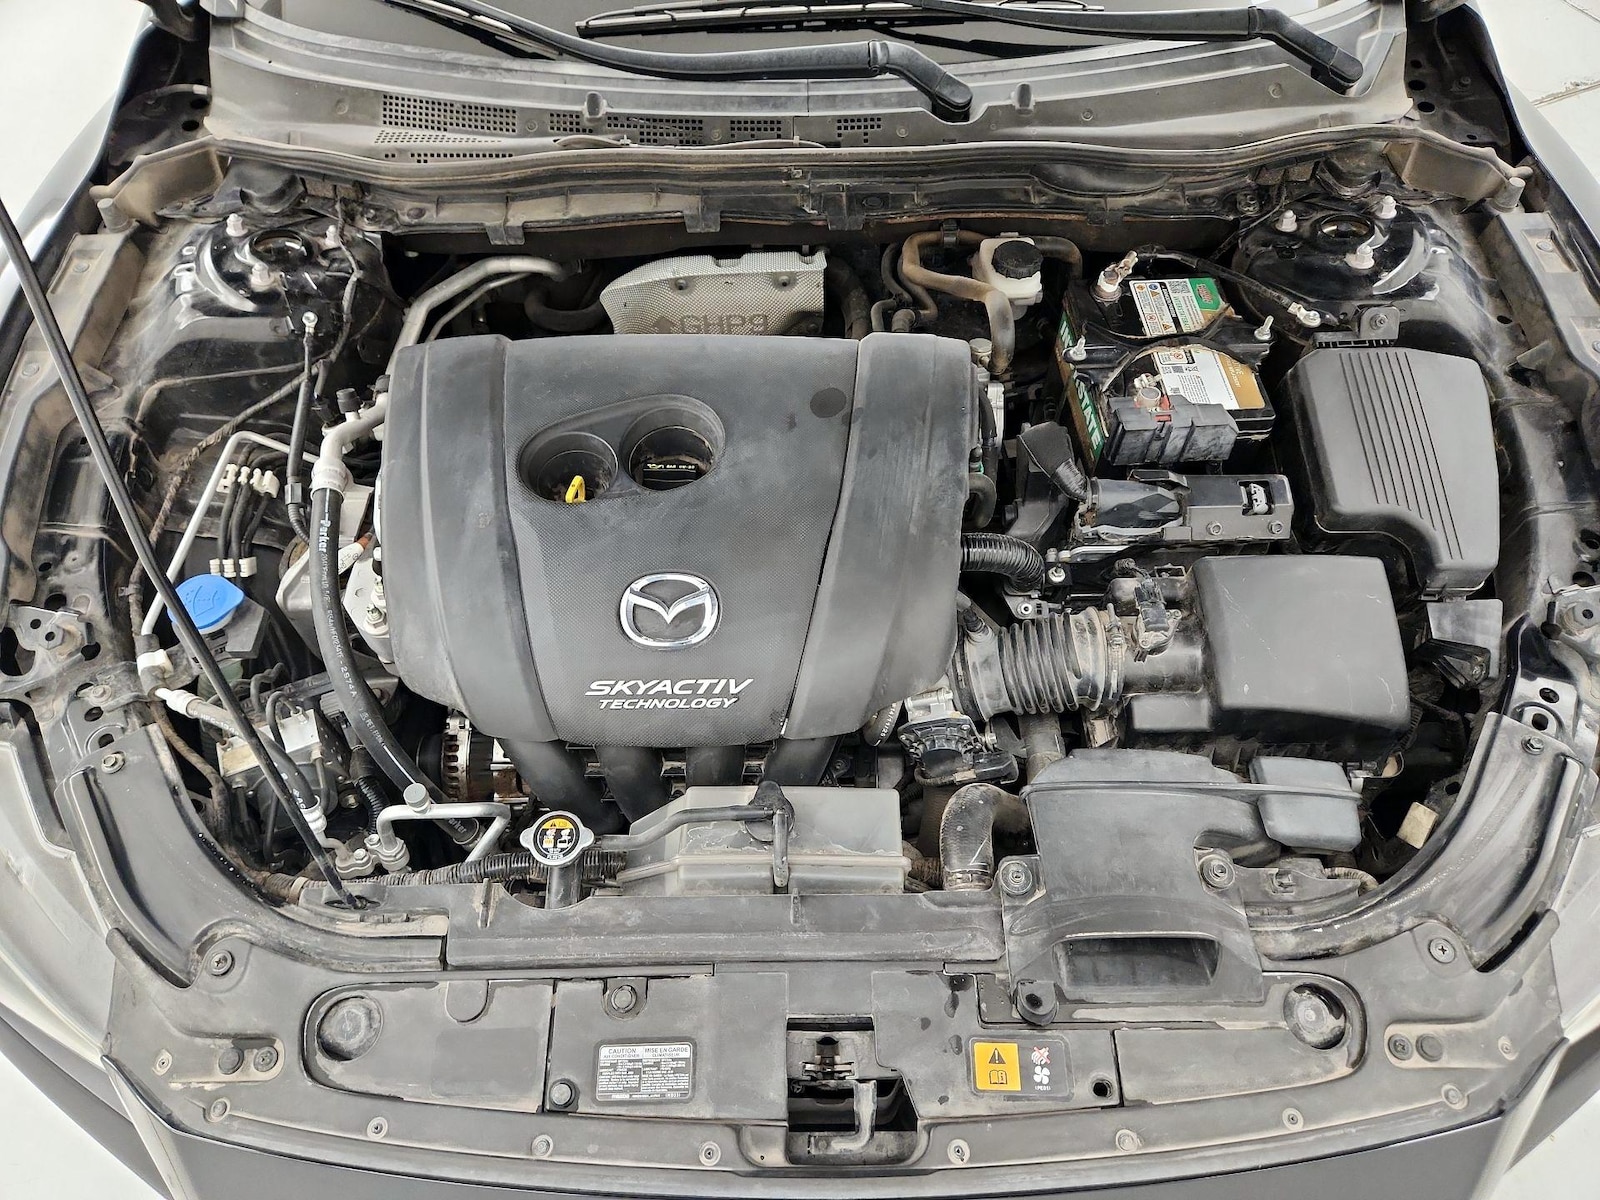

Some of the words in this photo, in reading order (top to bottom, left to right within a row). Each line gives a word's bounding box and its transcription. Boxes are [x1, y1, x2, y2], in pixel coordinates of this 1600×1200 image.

[318, 519, 332, 553] Parker
[585, 678, 754, 696] SKYACTIV
[599, 697, 739, 709] TECHNOLOGY
[448, 818, 467, 833] arker
